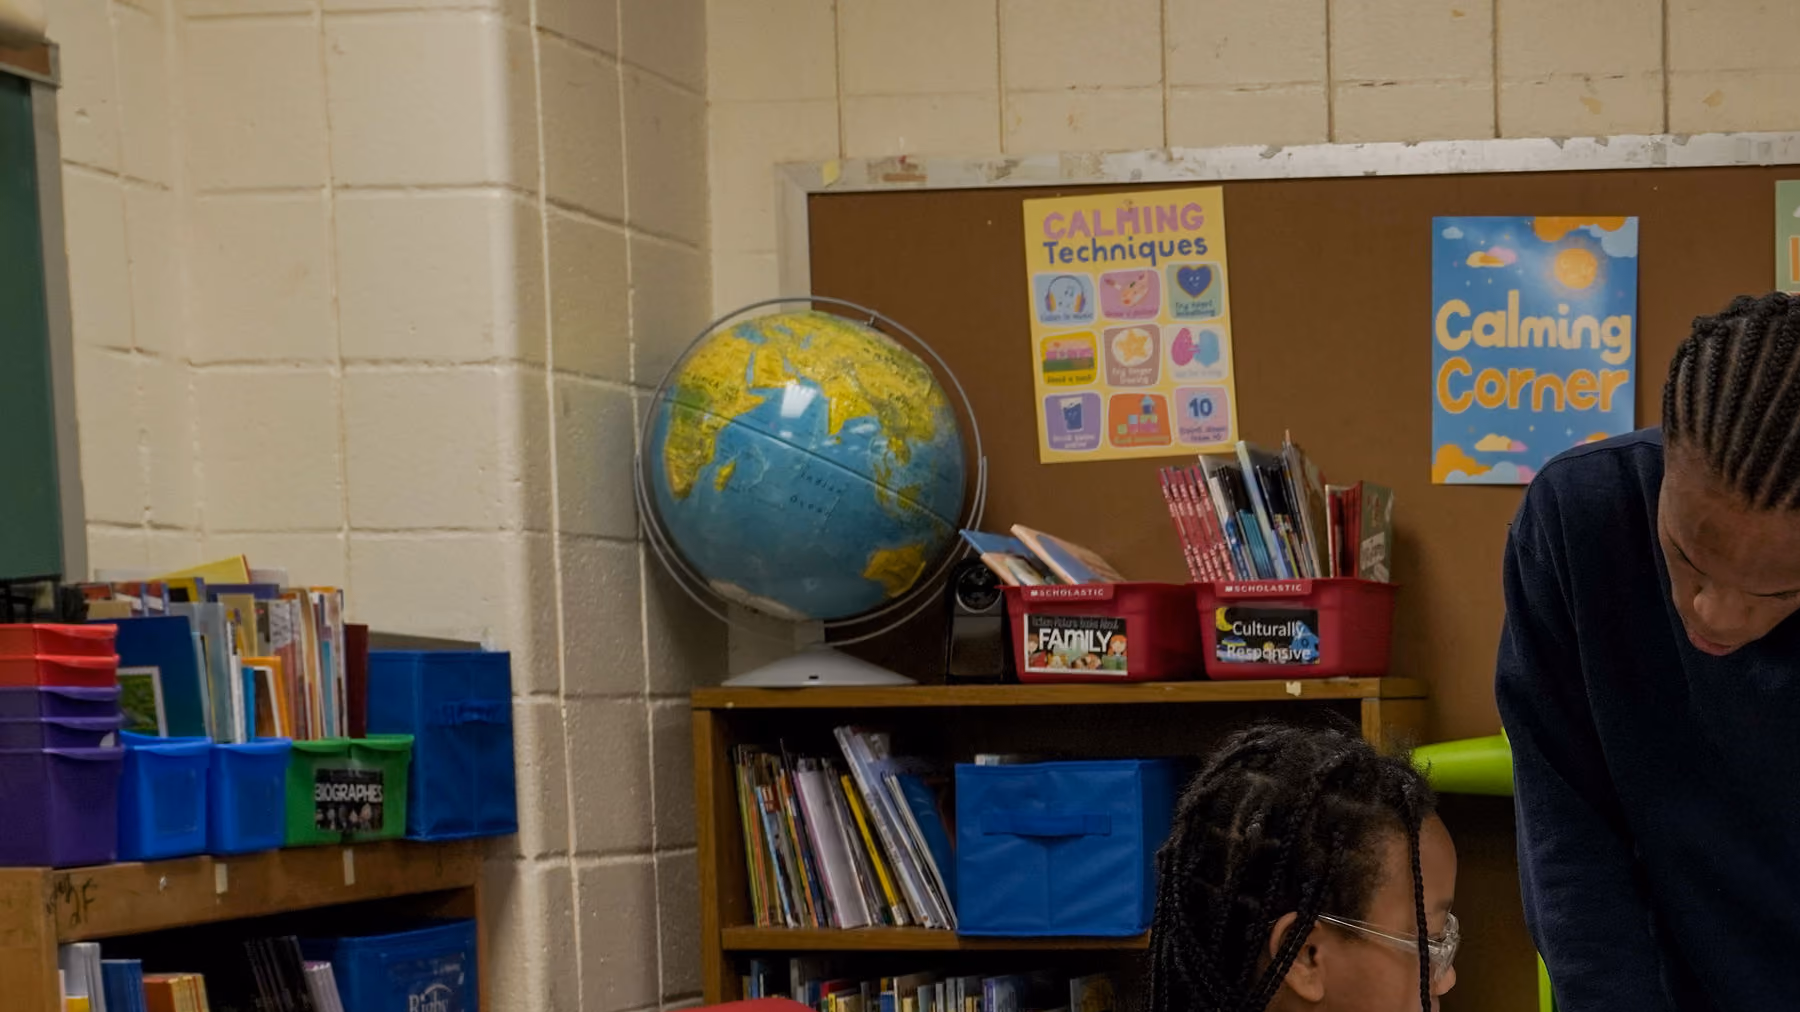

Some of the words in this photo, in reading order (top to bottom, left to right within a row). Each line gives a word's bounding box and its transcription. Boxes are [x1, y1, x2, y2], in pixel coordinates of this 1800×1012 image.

[1043, 202, 1205, 241] CALMING
[1043, 236, 1208, 266] Techniques
[1435, 289, 1632, 365] Calming
[1437, 356, 1630, 414] Corner
[1187, 397, 1214, 418] 10
[1039, 588, 1104, 597] SCHOLASTIC
[1233, 583, 1303, 593] SCHOLASTIC
[1232, 619, 1305, 639] Culturally
[1226, 644, 1312, 662] Responsive
